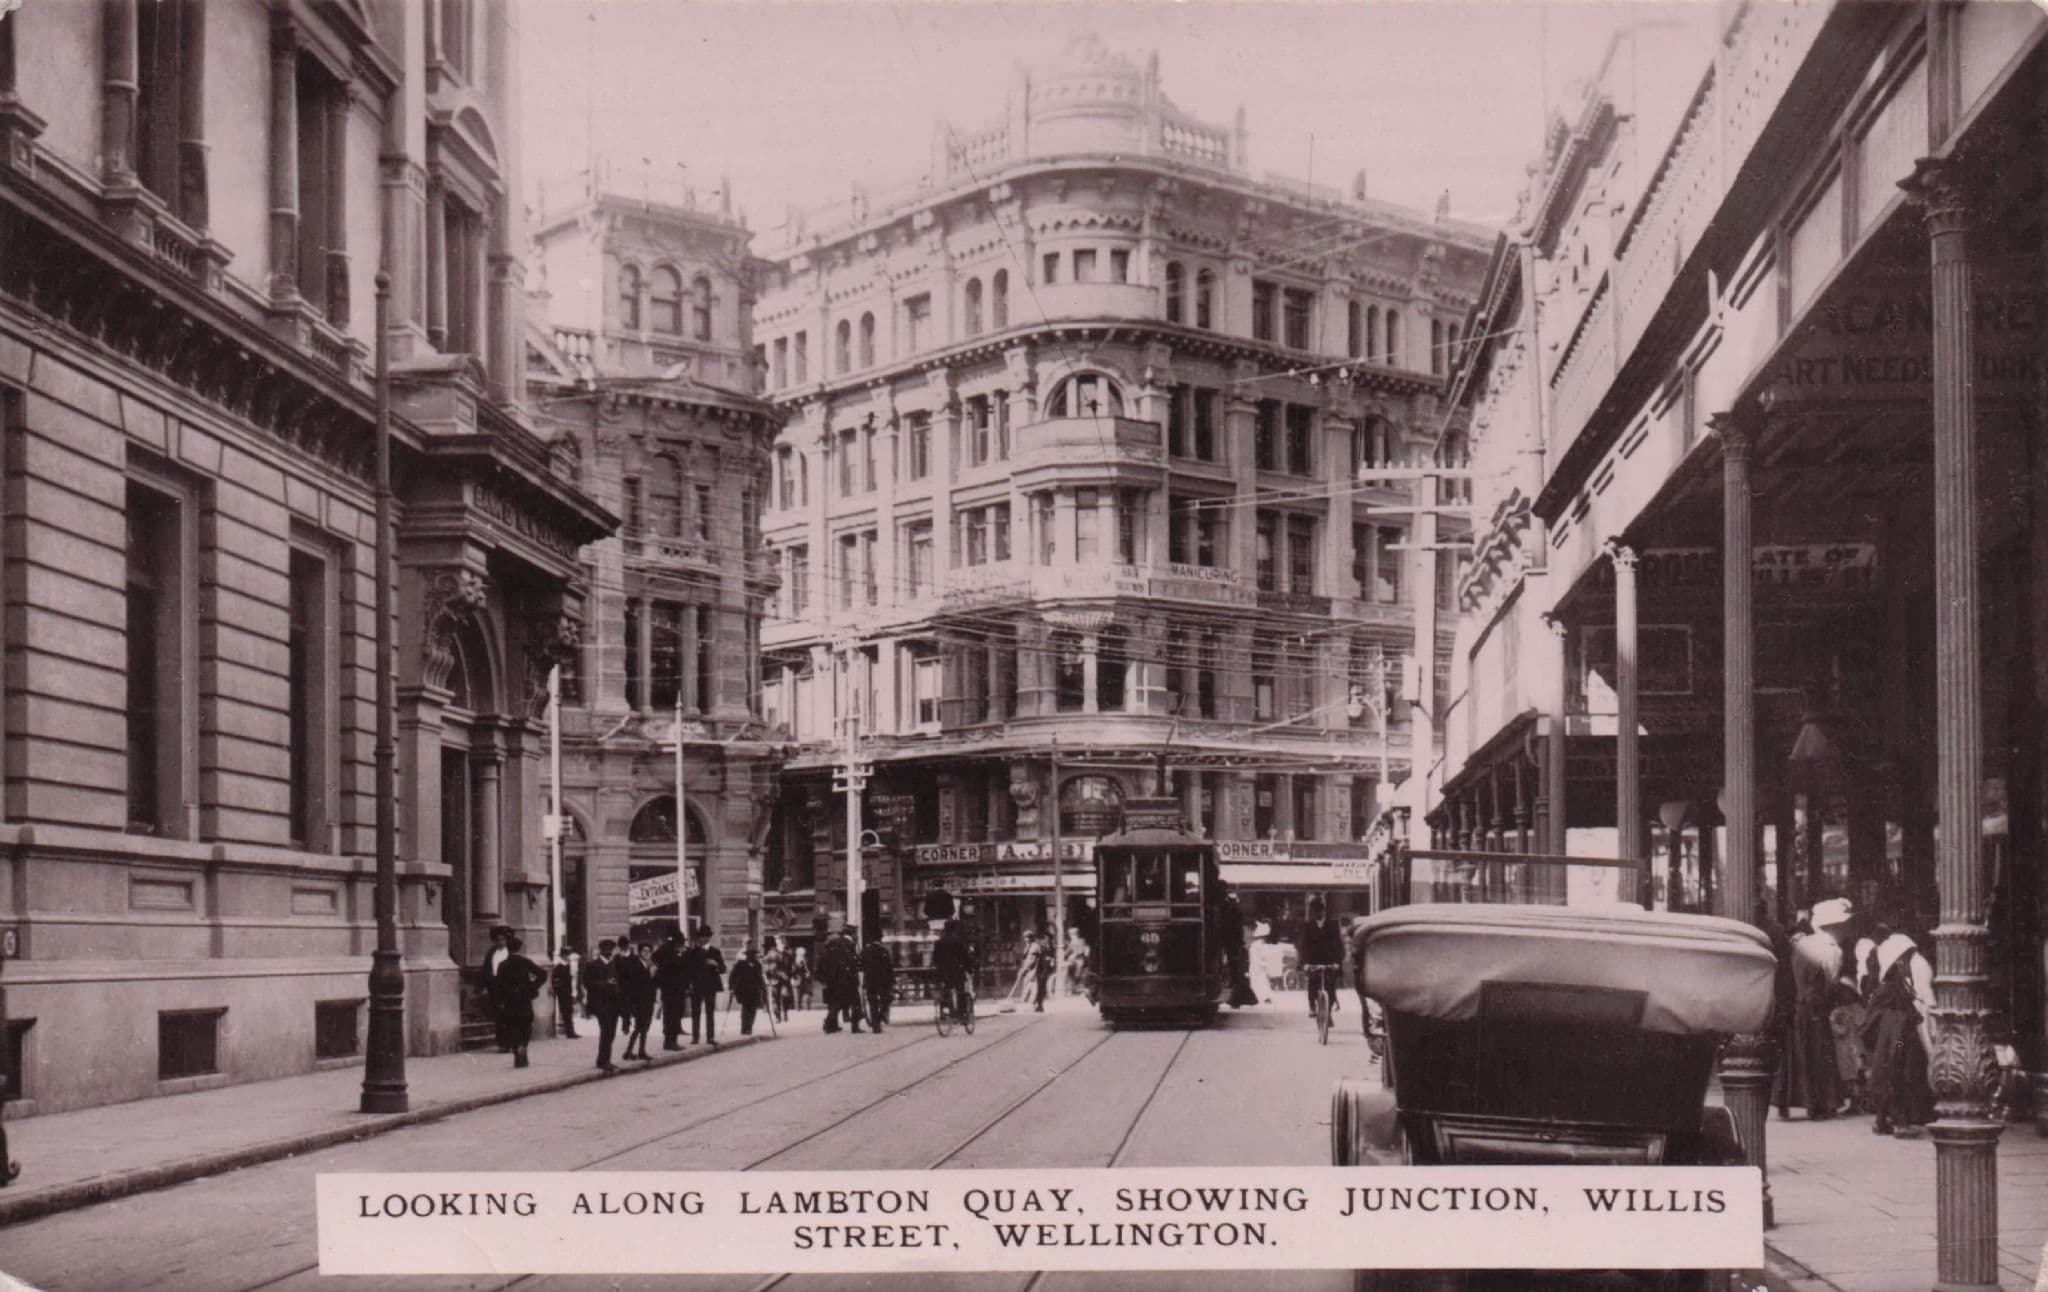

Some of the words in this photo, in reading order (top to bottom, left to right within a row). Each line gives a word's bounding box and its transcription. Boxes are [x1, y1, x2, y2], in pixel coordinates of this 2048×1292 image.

[1778, 357, 1838, 385] ART
[1170, 564, 1239, 583] MANICURING
[921, 847, 977, 862] CORNER
